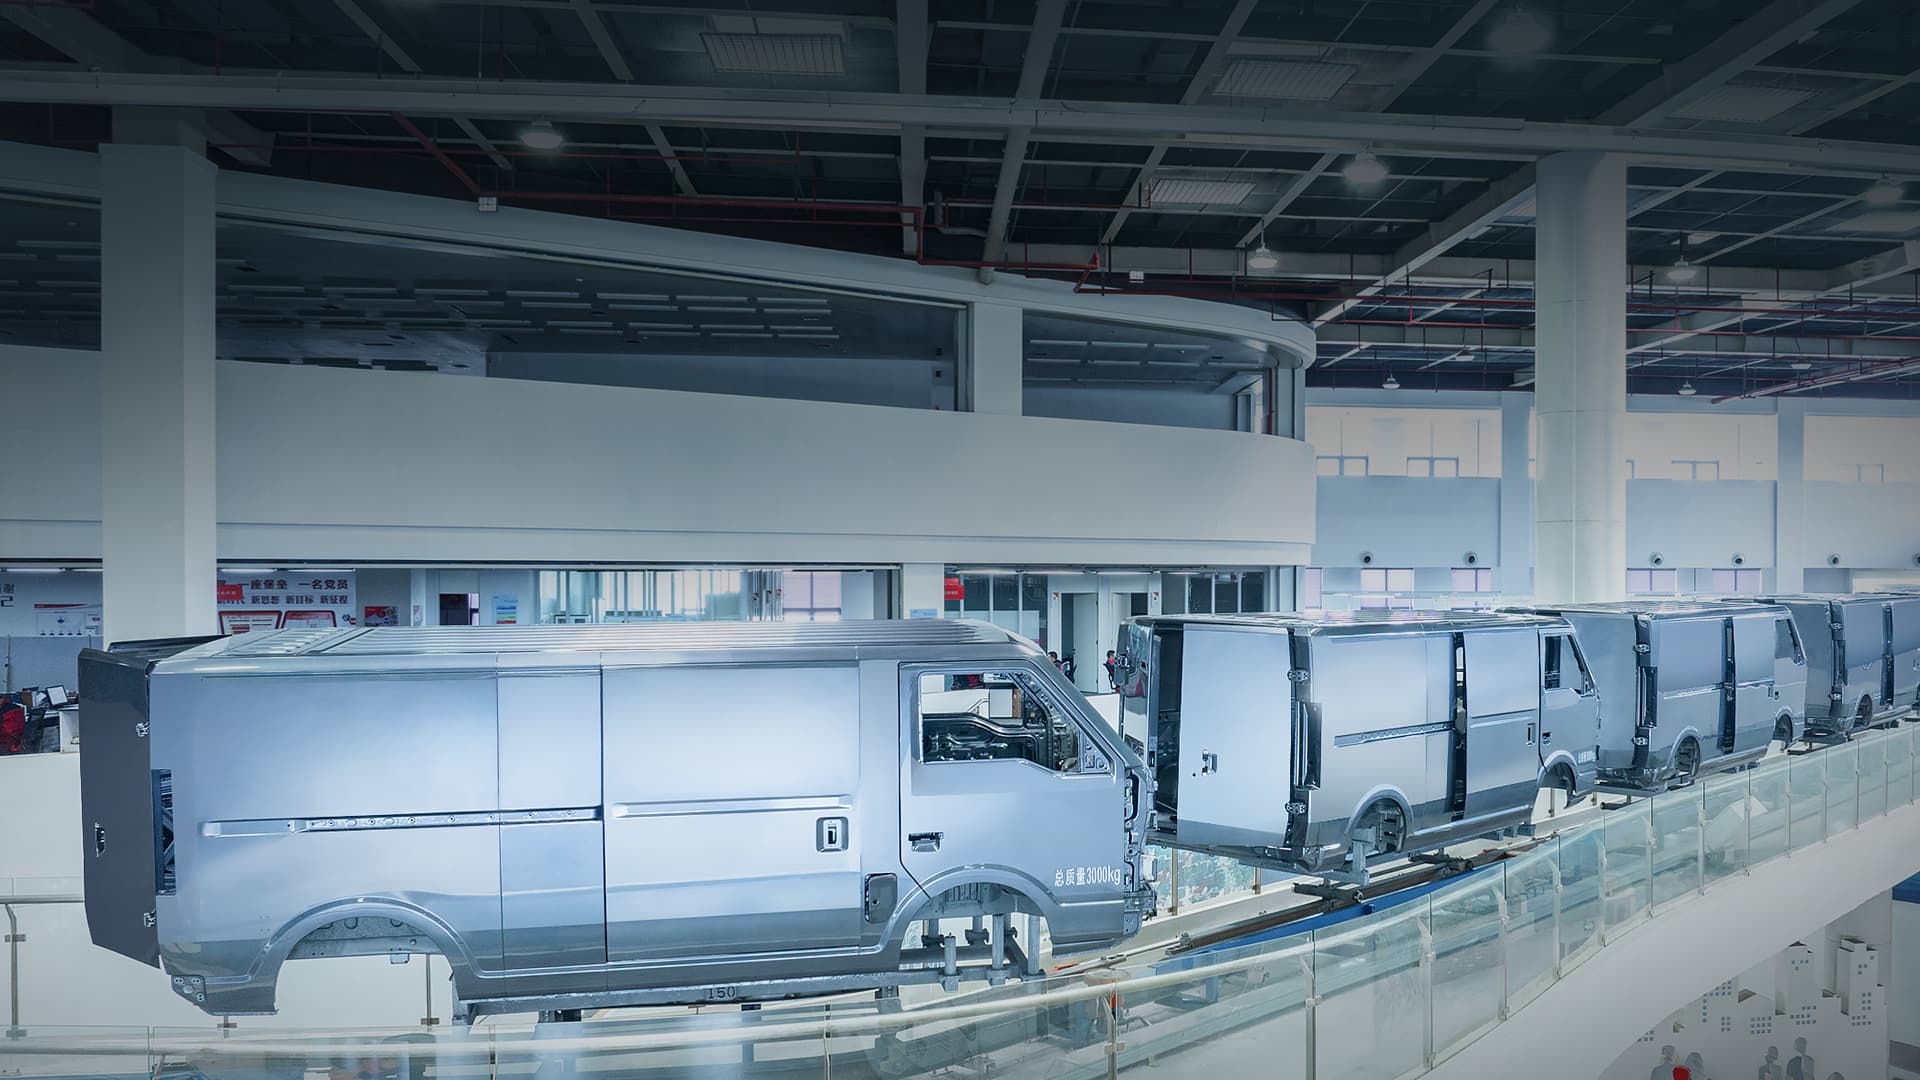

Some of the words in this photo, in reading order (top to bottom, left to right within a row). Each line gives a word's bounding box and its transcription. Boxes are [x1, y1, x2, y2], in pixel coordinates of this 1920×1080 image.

[298, 579, 348, 590] 一名党员
[1054, 865, 1121, 887] 总质量3000kg
[708, 986, 736, 999] 150
